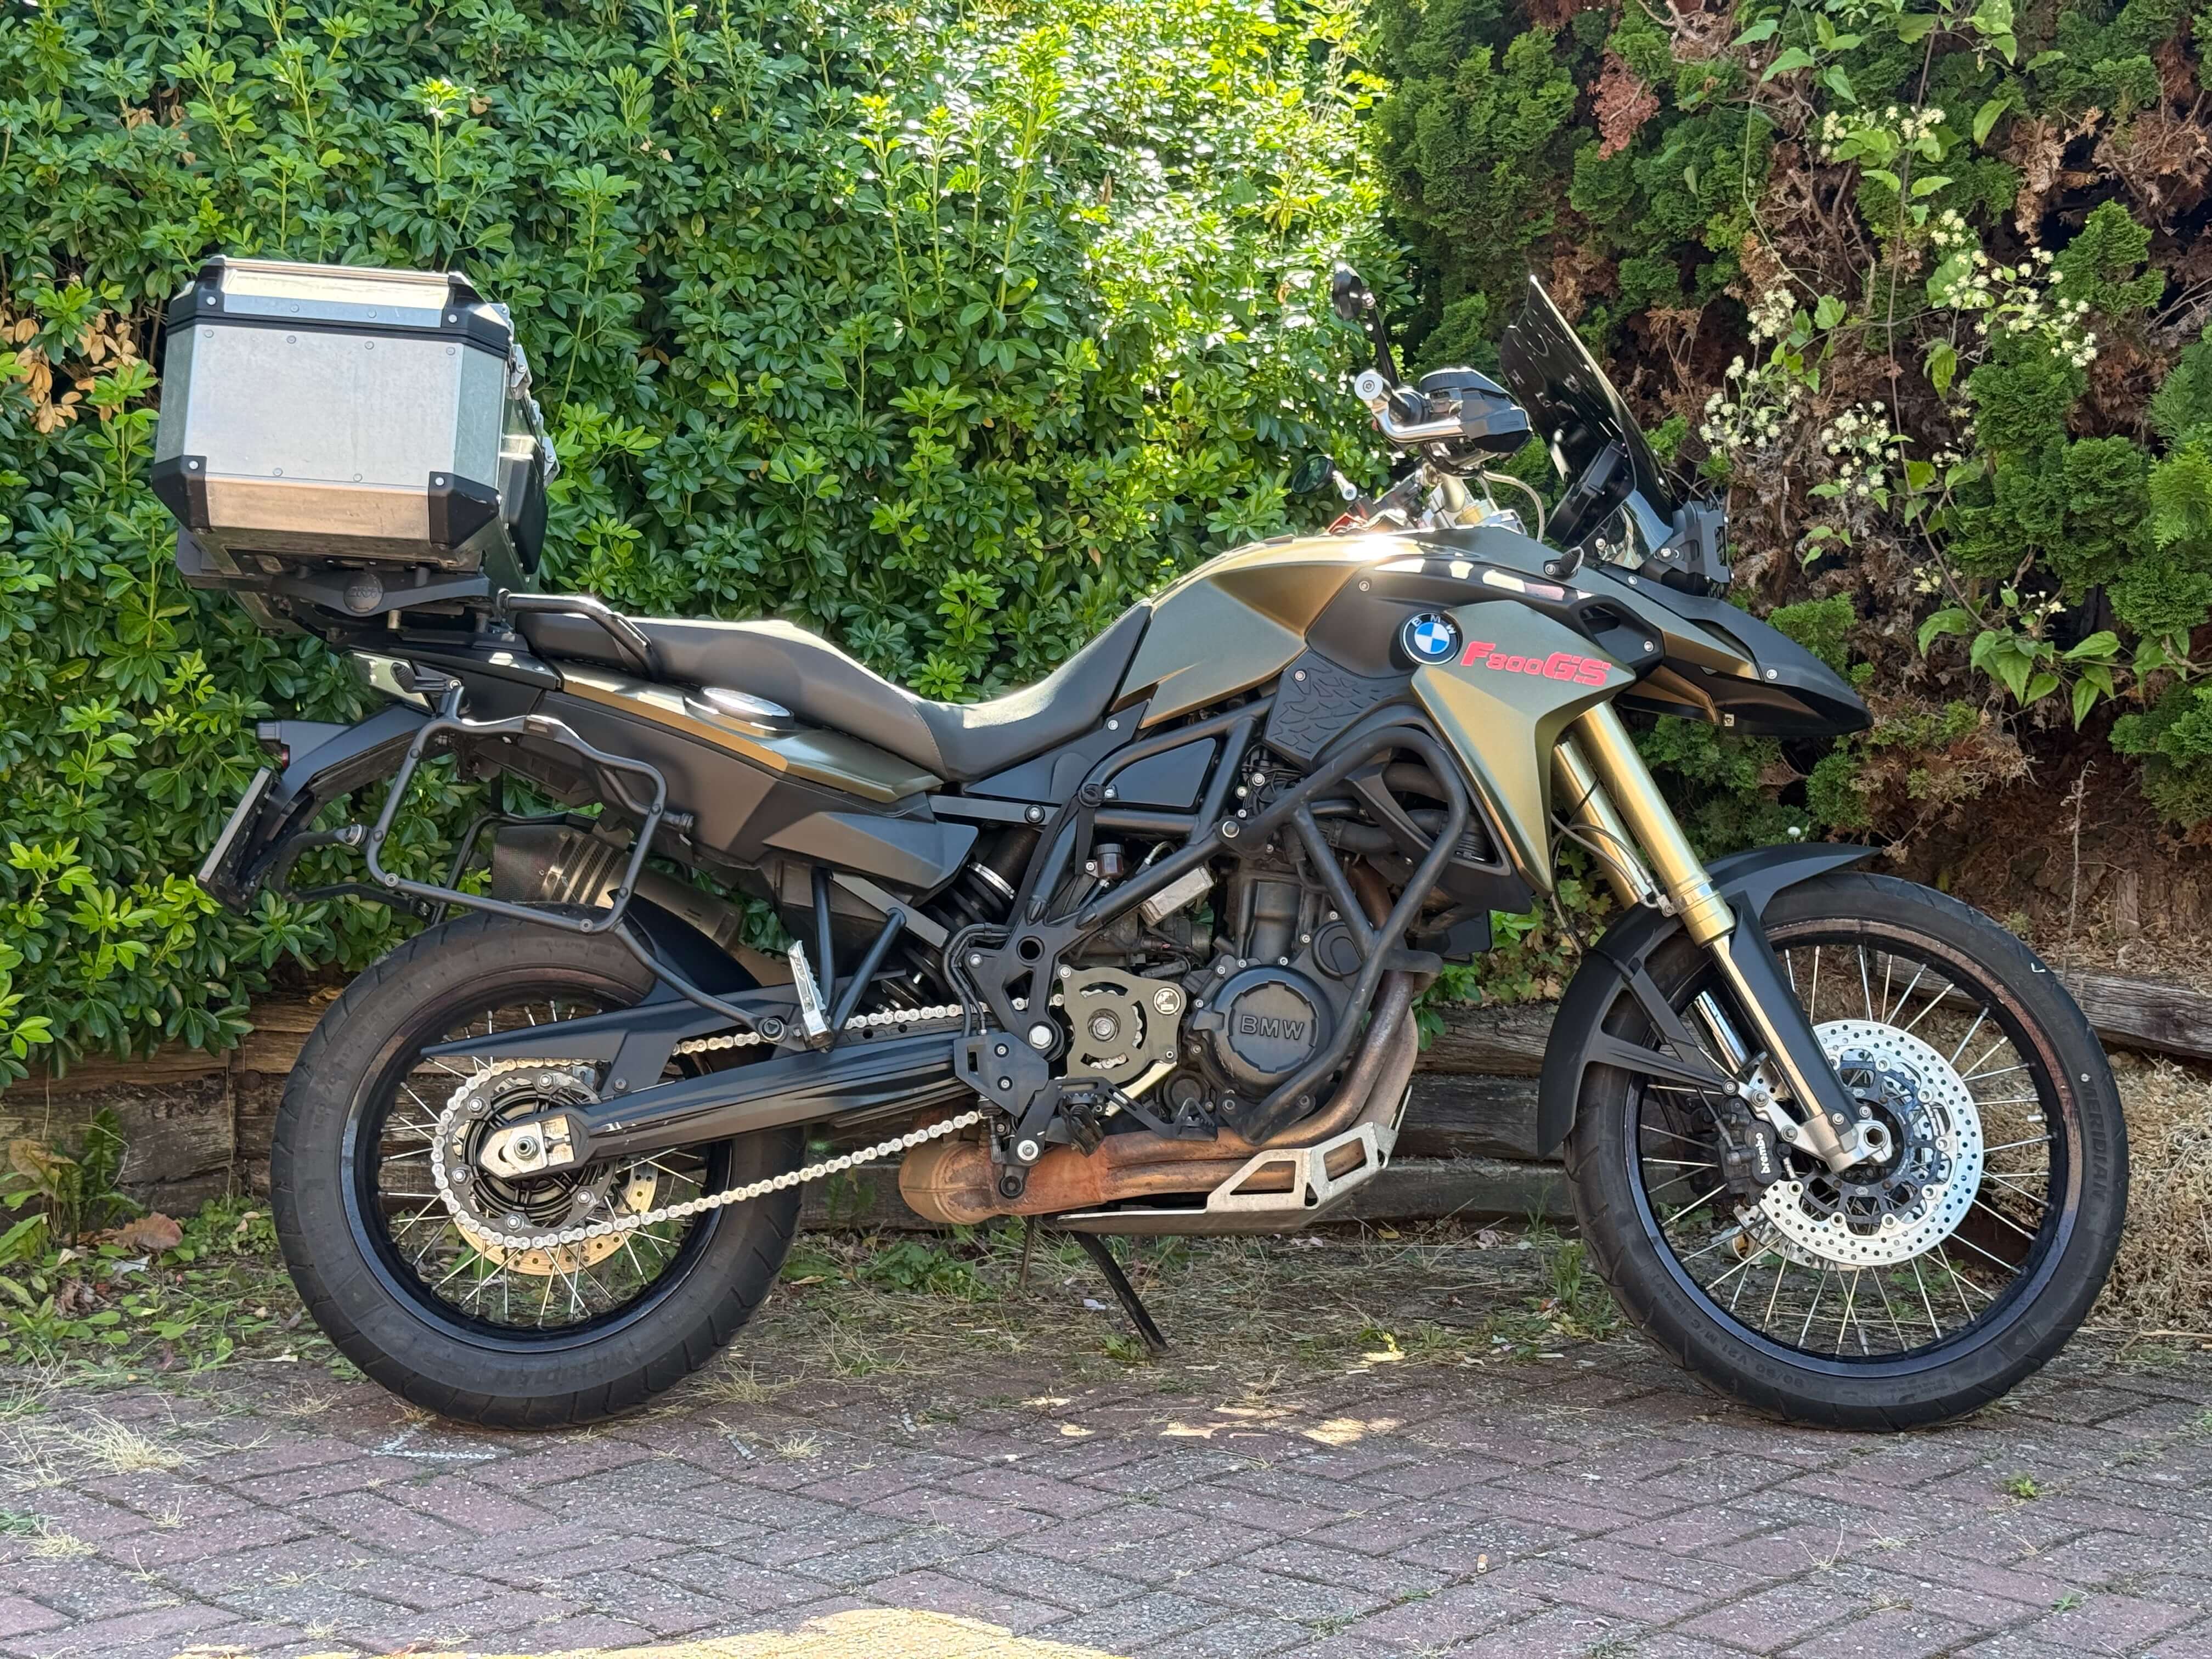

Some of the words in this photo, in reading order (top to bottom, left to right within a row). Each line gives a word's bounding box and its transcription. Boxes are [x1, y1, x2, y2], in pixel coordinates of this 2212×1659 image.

[1412, 614, 1457, 634] BMW
[1460, 641, 1612, 686] F800GS
[1240, 1014, 1305, 1040] BMW
[1756, 1132, 1771, 1174] brembo
